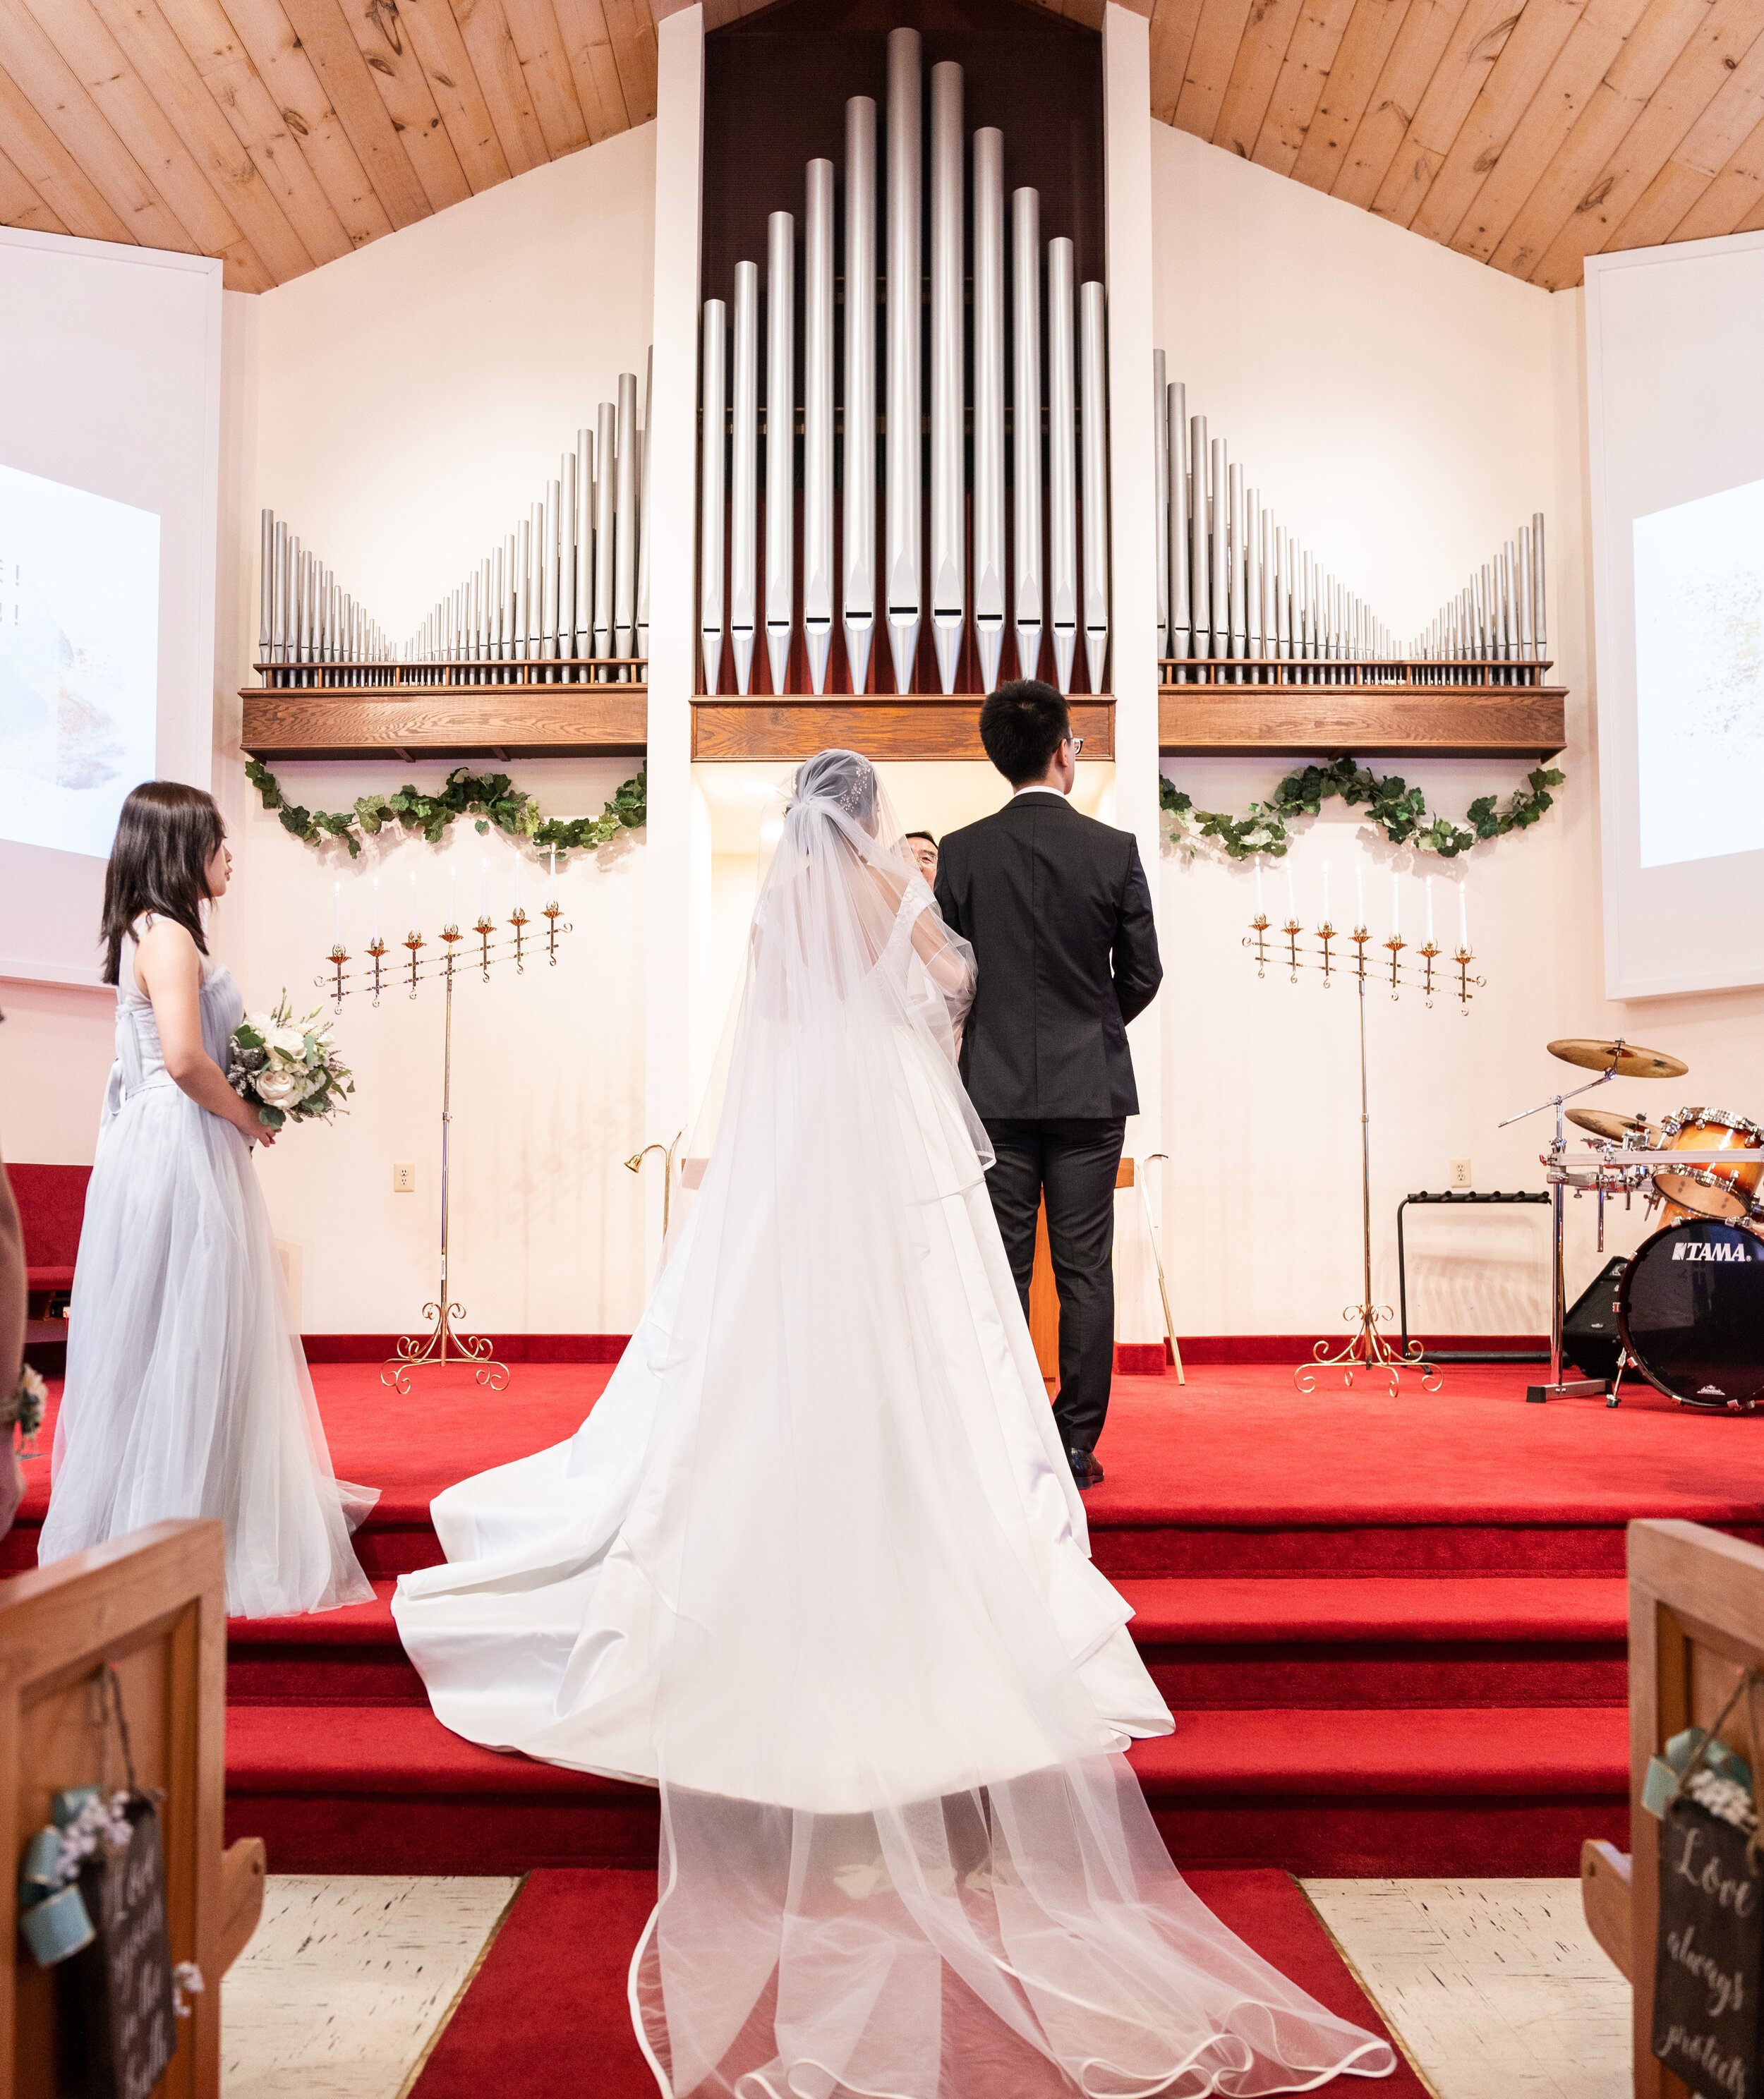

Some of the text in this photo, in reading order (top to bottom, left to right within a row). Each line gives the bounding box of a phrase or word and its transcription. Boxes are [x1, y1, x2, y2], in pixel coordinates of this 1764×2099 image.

[1686, 1242, 1746, 1262] TAMA
[1676, 1828, 1753, 1918] Love
[1667, 1925, 1744, 2017] always
